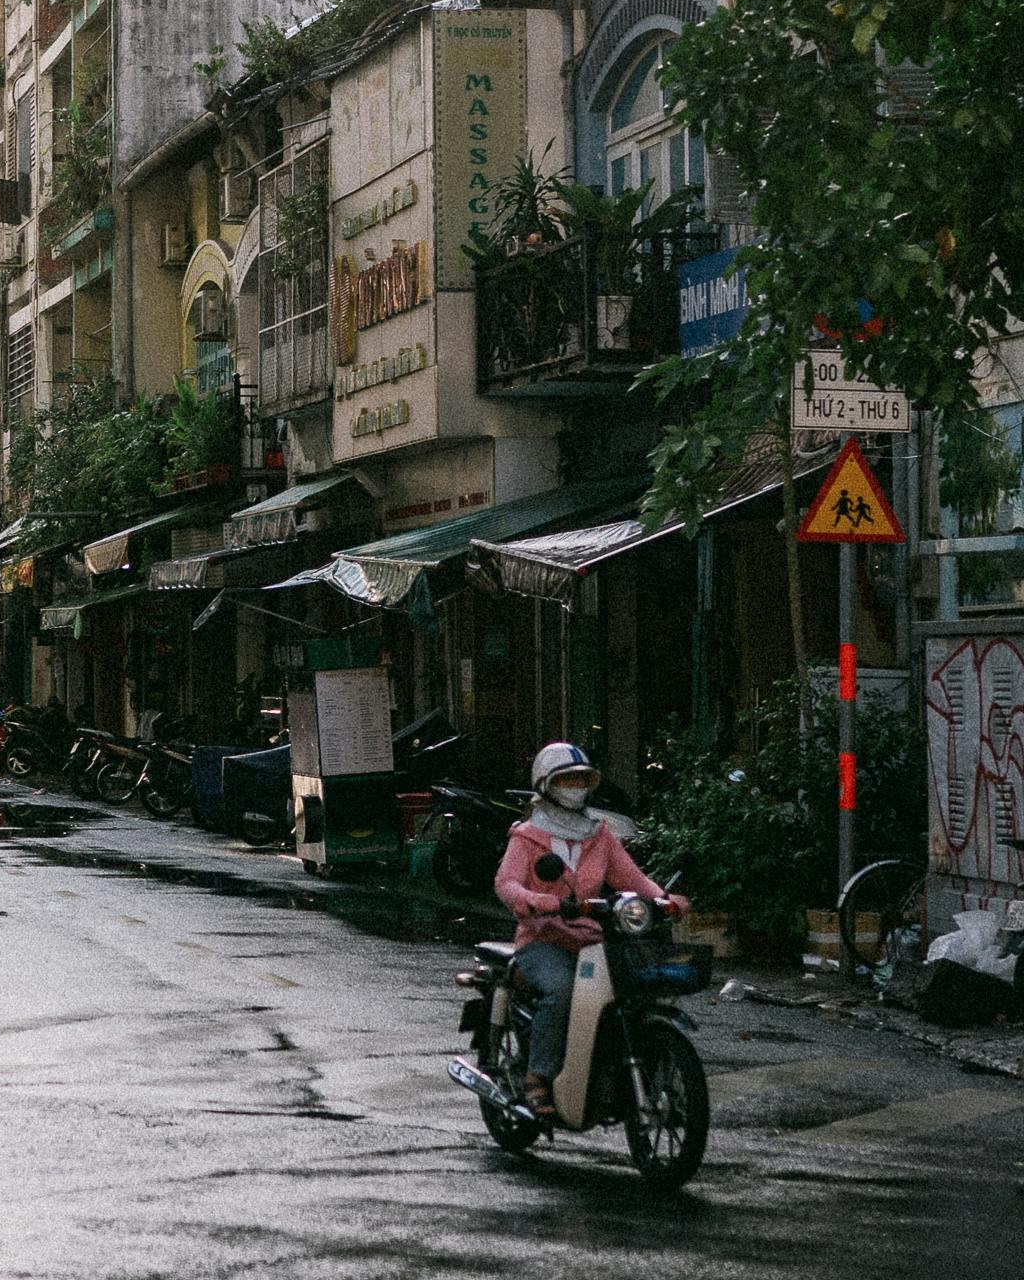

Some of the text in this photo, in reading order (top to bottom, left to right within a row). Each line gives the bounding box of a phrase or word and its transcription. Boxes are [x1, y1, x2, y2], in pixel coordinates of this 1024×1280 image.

[464, 74, 494, 241] MASSAGE
[680, 277, 707, 325] BÌNH
[709, 272, 739, 316] MINH
[804, 394, 834, 418] THỨ
[837, 400, 845, 418] 2
[858, 395, 888, 419] THỨ
[892, 401, 900, 419] 6
